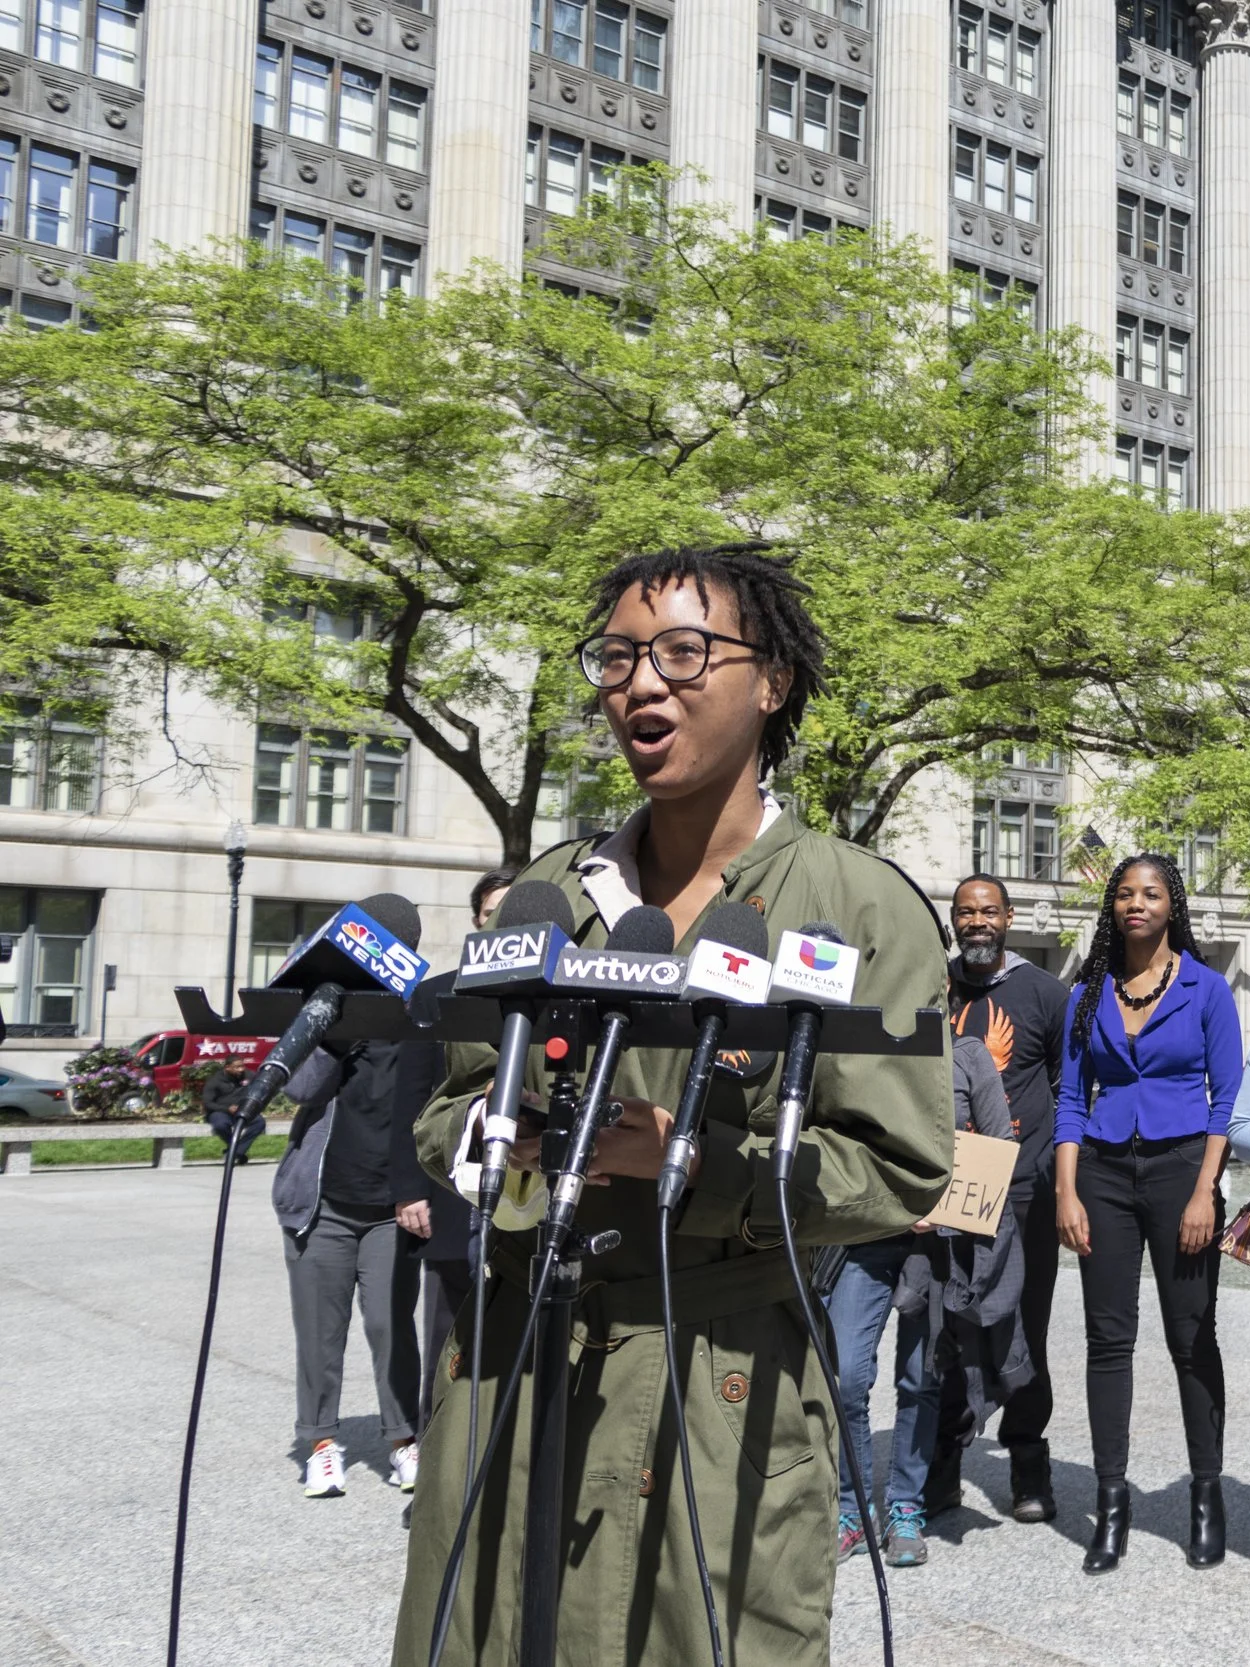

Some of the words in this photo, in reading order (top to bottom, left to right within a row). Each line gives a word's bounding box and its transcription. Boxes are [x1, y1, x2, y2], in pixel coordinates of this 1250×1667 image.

[335, 931, 406, 993] NEWS
[382, 942, 421, 981] 5
[467, 930, 546, 965] WGN
[486, 960, 515, 971] NEWS
[563, 956, 653, 983] wttw
[783, 968, 844, 989] NOTICIAS
[227, 1041, 258, 1053] VET
[937, 1179, 1004, 1223] FEW
